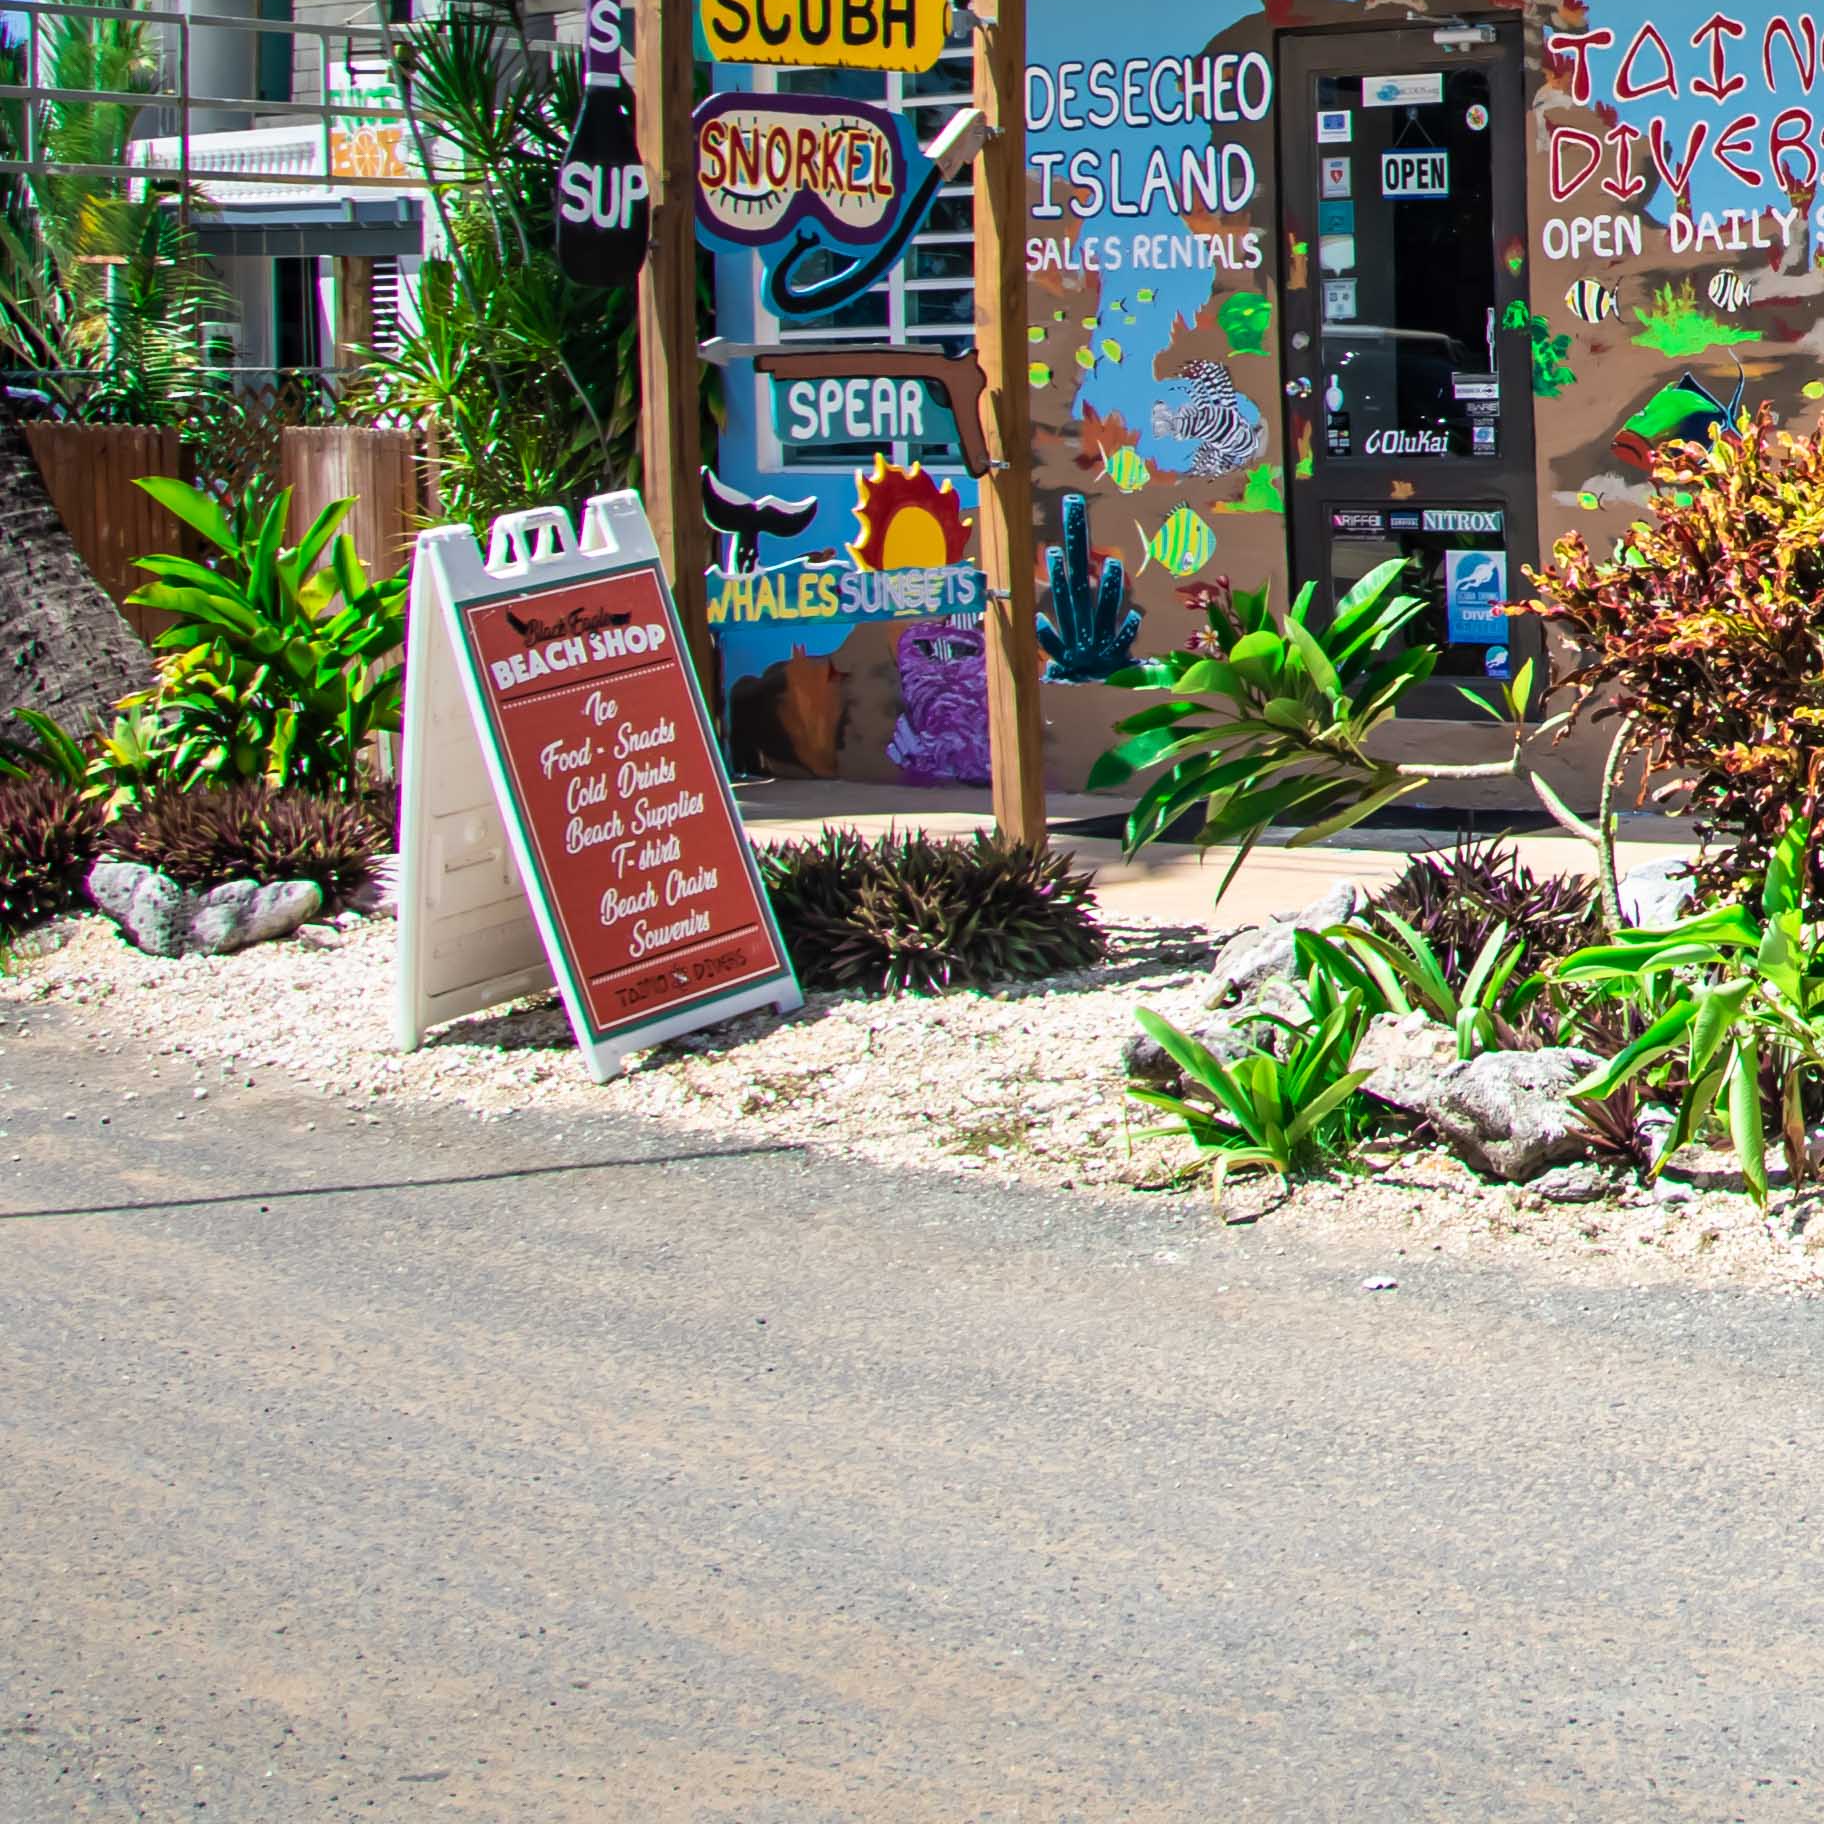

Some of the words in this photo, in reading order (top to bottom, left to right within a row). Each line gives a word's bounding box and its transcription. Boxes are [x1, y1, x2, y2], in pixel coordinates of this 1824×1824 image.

[1025, 52, 1273, 132] DESECHEO
[699, 118, 895, 197] SNORKEL
[1030, 143, 1256, 218] ISLAND
[1385, 157, 1445, 190] OPEN
[560, 162, 649, 232] SUP
[1025, 235, 1122, 272] SALES
[1132, 232, 1264, 271] RENTALS
[1543, 214, 1641, 260] OPEN
[1670, 206, 1799, 254] DAILY
[788, 377, 924, 440] SPEAR
[1381, 429, 1450, 454] OluKai
[1422, 512, 1498, 531] NITROX
[707, 572, 839, 624] WHALES
[838, 565, 976, 614] SUNSETS
[490, 634, 588, 691] BEACH
[590, 623, 666, 662] SHOP
[582, 691, 618, 726] Ice
[540, 737, 592, 780] Food
[613, 717, 676, 760] Snacks
[566, 773, 608, 815] Cold
[617, 756, 677, 799] Drinks
[565, 810, 624, 854] Beach
[631, 790, 704, 836] Supplies
[600, 881, 659, 926] Beach
[665, 866, 718, 907] Chairs
[629, 909, 711, 958] Souvenirs
